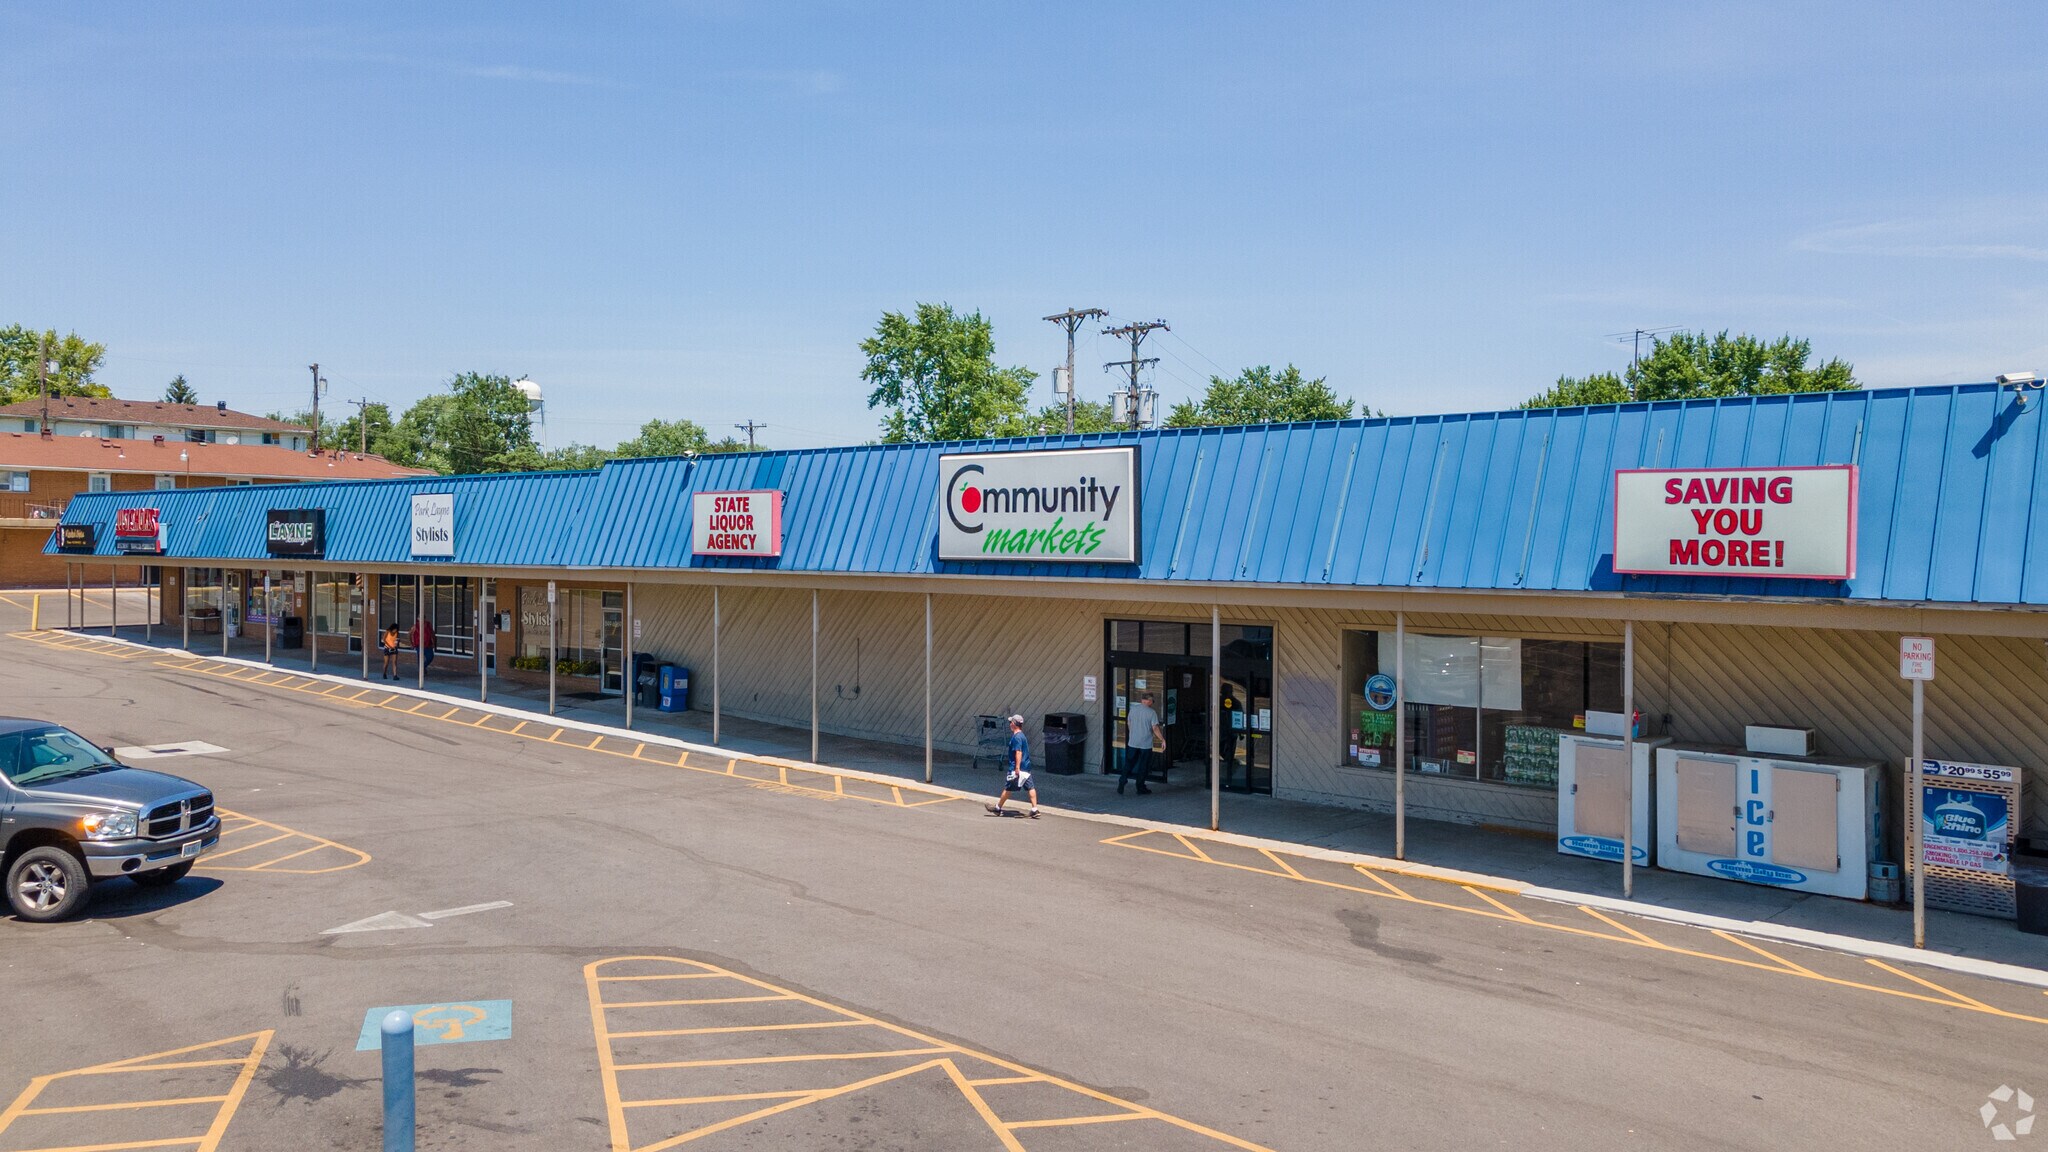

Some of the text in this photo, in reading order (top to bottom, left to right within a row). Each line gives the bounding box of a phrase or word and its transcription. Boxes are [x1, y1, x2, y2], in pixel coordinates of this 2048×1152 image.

[947, 464, 1120, 533] Community
[1664, 476, 1793, 505] SAVING
[414, 500, 430, 517] Park
[714, 496, 750, 513] STATE
[709, 514, 754, 533] LIQUOR
[1691, 508, 1763, 535] YOU
[269, 522, 313, 541] LAYNE
[415, 526, 449, 545] Stylists
[982, 516, 1106, 555] markets
[707, 533, 757, 550] AGENCY
[1669, 539, 1785, 567] MORE!
[1912, 642, 1923, 652] NO
[1903, 651, 1932, 662] PARKING
[1945, 813, 1976, 826] Blue
[1924, 855, 1960, 865] FLAMMABLE
[1925, 849, 1952, 859] SMOKING
